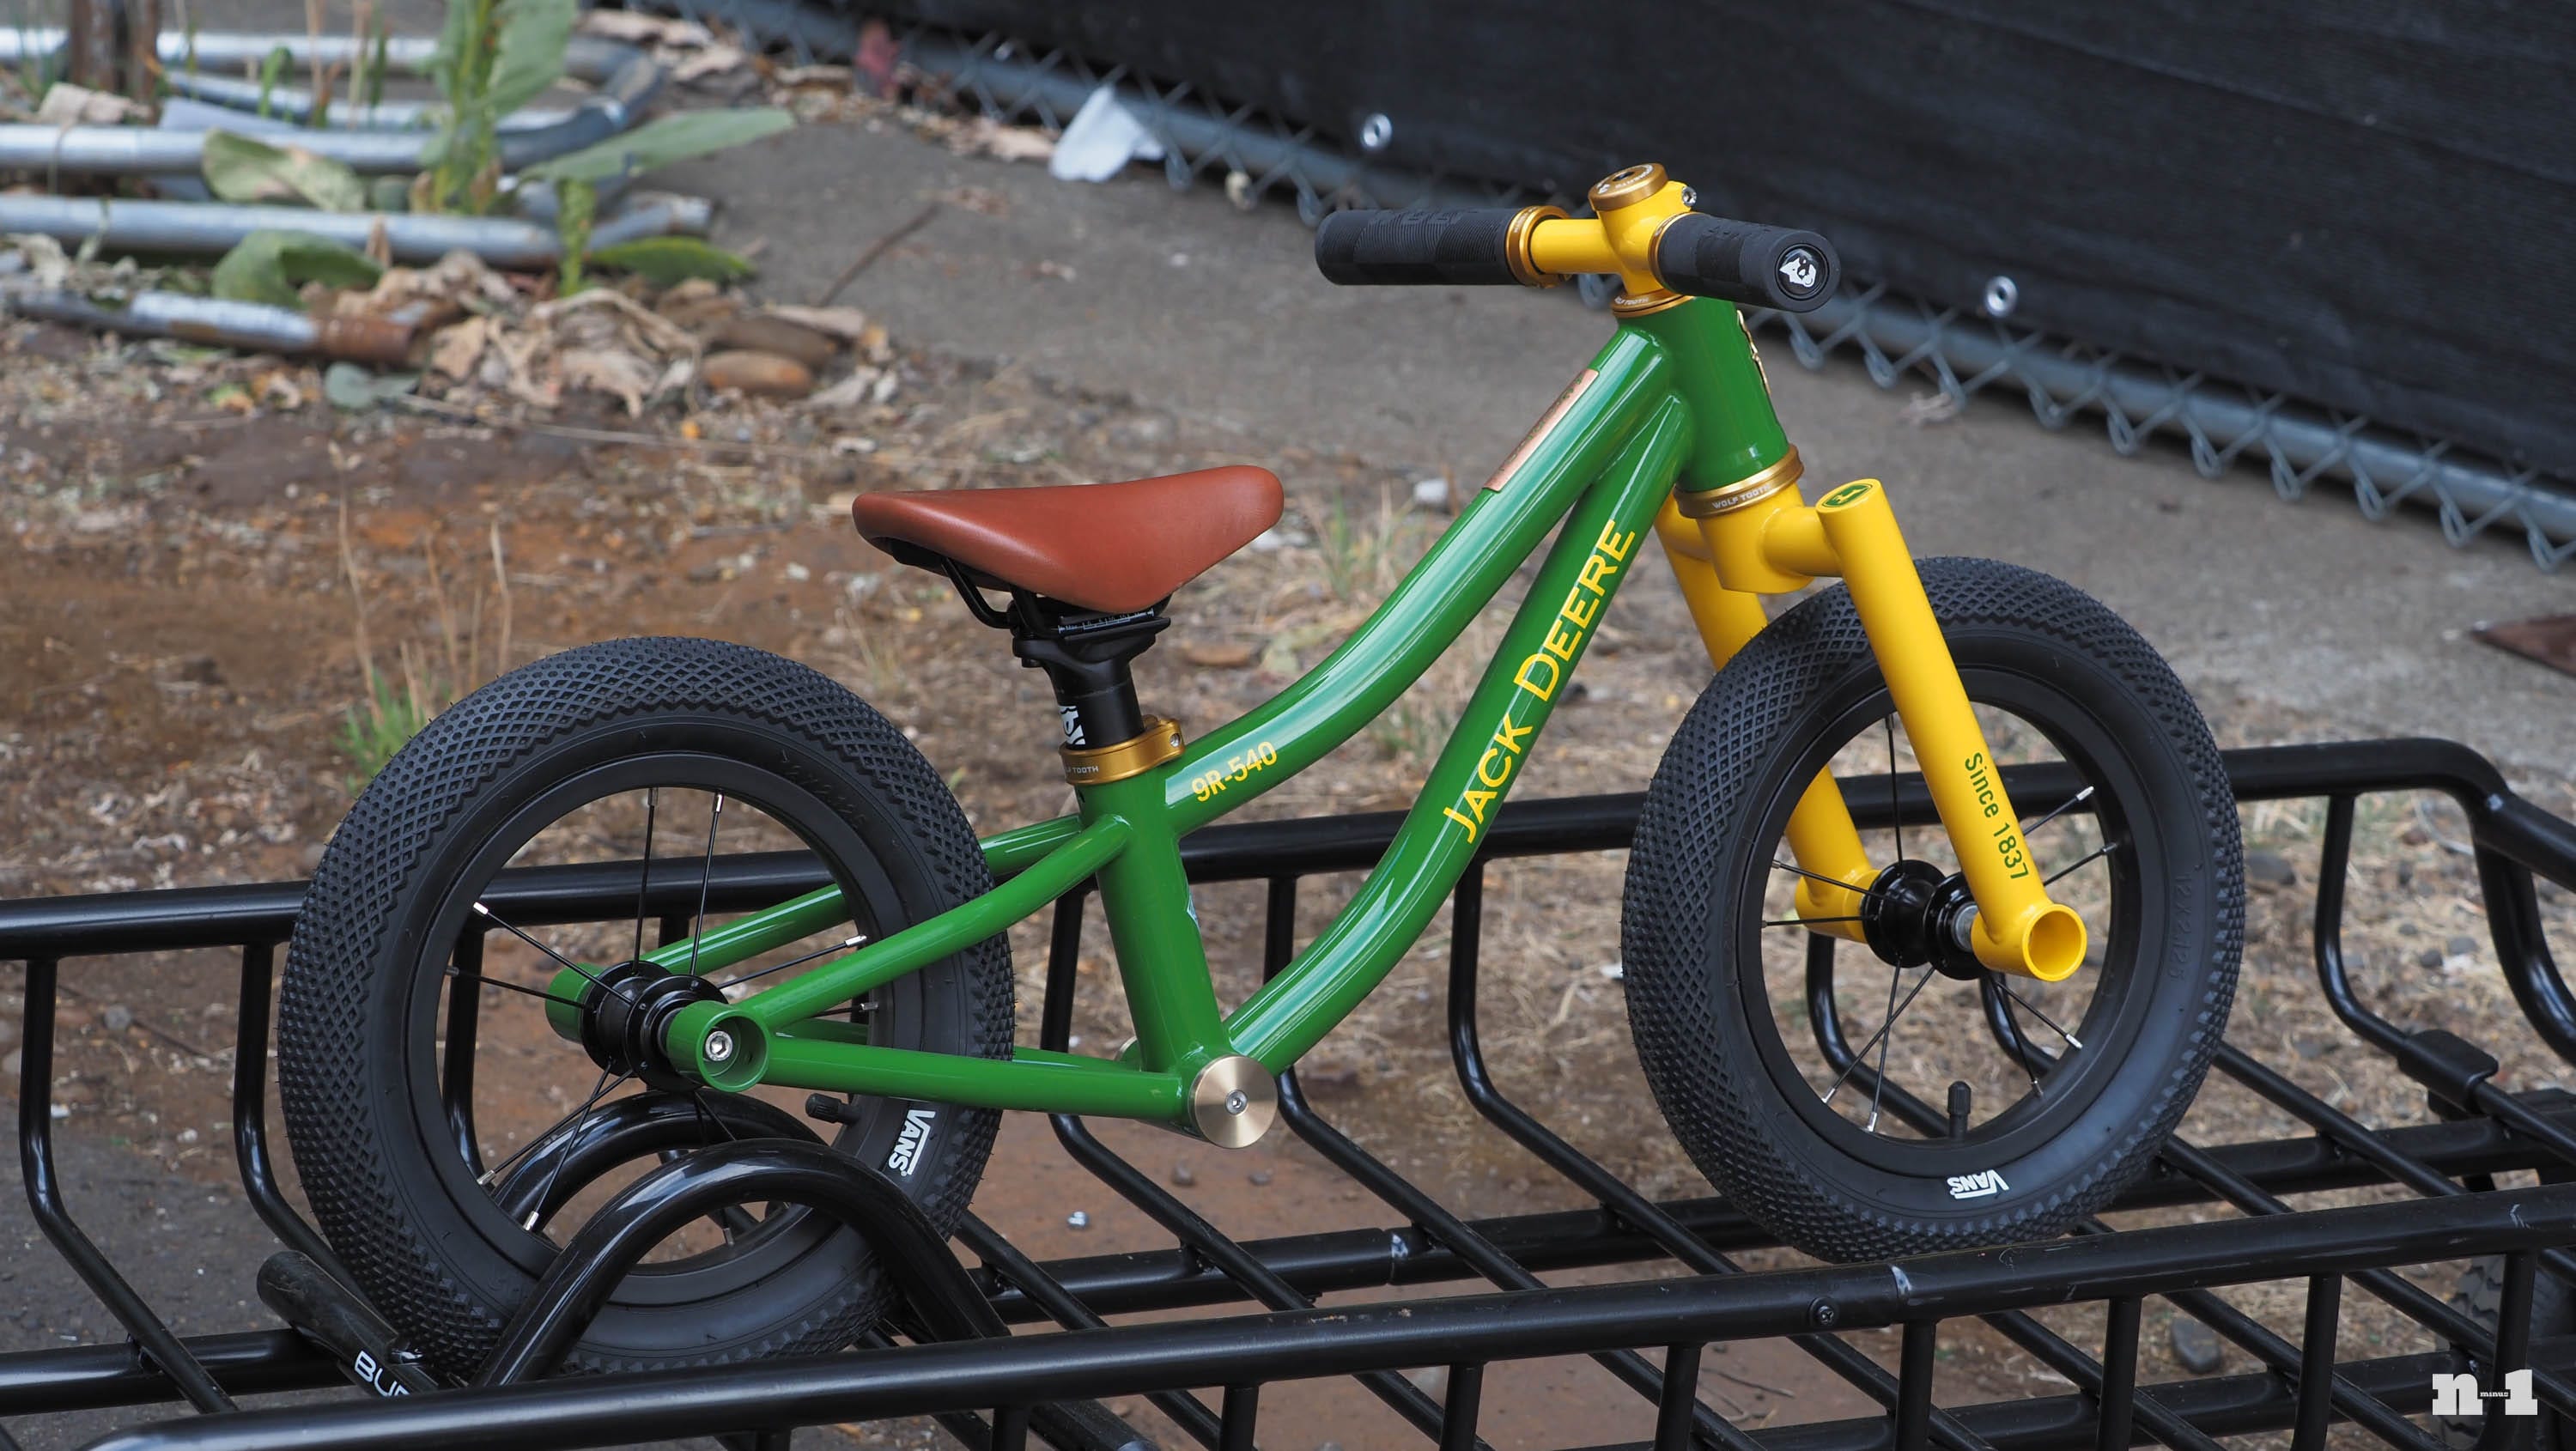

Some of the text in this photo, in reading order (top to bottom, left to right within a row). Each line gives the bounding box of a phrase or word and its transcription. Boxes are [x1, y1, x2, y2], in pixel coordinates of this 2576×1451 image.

[1711, 484, 1771, 510] WOLF TOOTH
[1443, 713, 1533, 843] JACK
[1513, 519, 1636, 701] DEERE
[1191, 741, 1278, 802] 9R-540
[1965, 752, 2029, 879] Since 1837
[888, 1109, 936, 1176] VANS
[1947, 1169, 2009, 1199] VANS
